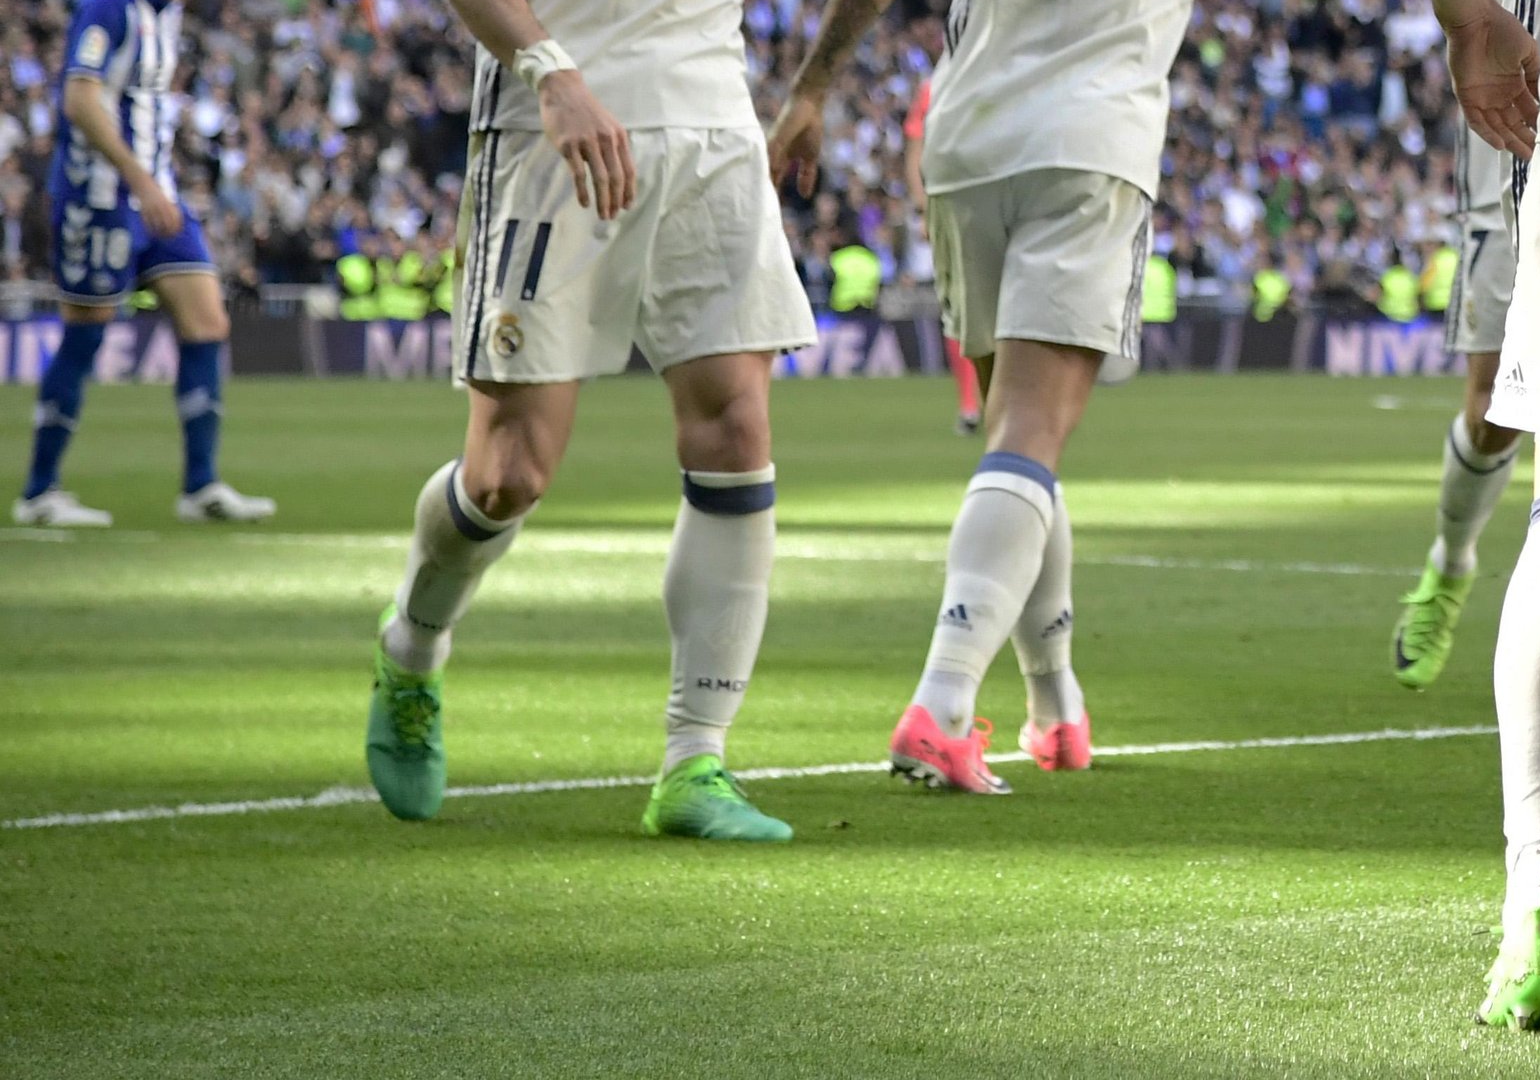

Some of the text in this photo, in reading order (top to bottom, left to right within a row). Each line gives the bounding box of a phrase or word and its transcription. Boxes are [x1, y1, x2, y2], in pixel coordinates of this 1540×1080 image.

[492, 218, 553, 301] 11
[1470, 229, 1490, 281] 7
[0, 320, 180, 384] IEA
[365, 321, 453, 379] ME
[773, 322, 906, 377] VEA
[1325, 322, 1469, 377] NIVE
[697, 677, 748, 692] RMC
